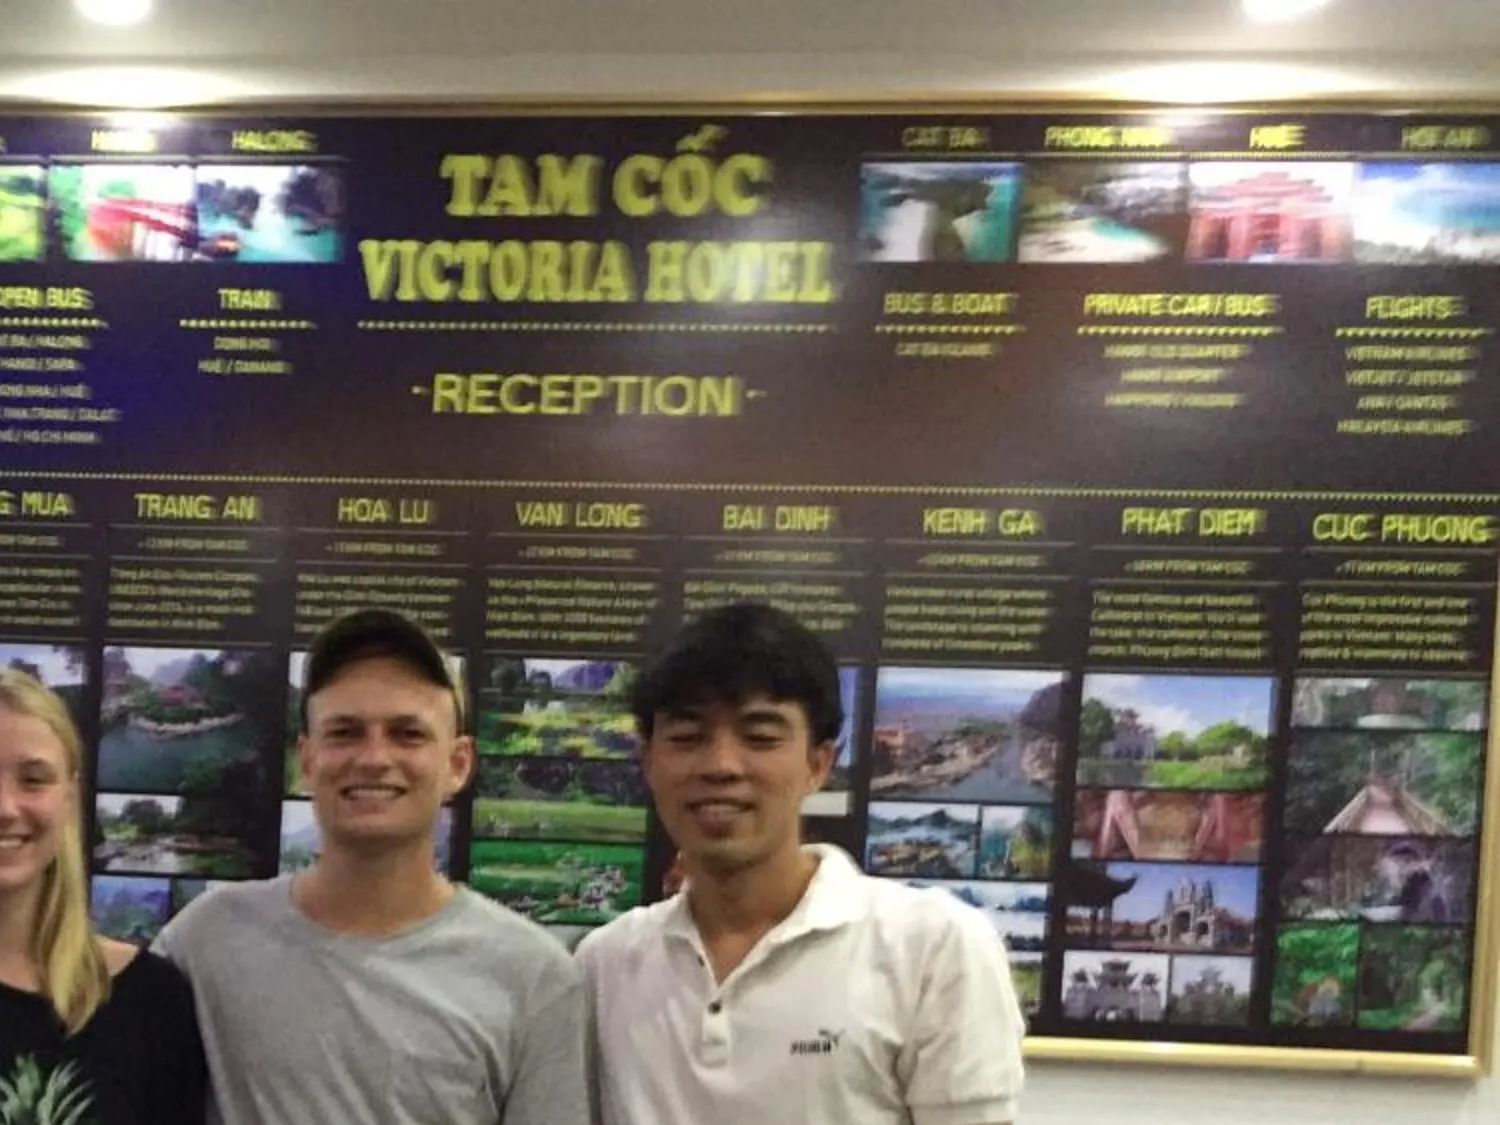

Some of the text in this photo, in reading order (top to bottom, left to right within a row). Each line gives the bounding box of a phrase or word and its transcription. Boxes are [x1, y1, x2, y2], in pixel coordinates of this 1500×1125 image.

[440, 152, 603, 217] TAM
[358, 239, 837, 303] VICTORIA HOTEL
[46, 288, 94, 309] BUS
[218, 288, 279, 310] TRAIN
[884, 292, 927, 314] BUS
[952, 292, 1016, 314] BOAT
[1084, 293, 1166, 316] PRIVATE
[1366, 295, 1466, 320] FLIGHTS
[21, 492, 73, 516] MUA
[133, 493, 260, 520] TRANG AN
[338, 498, 430, 523] HOA LU
[516, 502, 646, 528] VAN LONG
[723, 504, 834, 531] BAI DINH
[923, 508, 1043, 535] KENH GA
[1122, 508, 1264, 536] PHAT DIEM
[1312, 513, 1494, 543] CUC PHUONG
